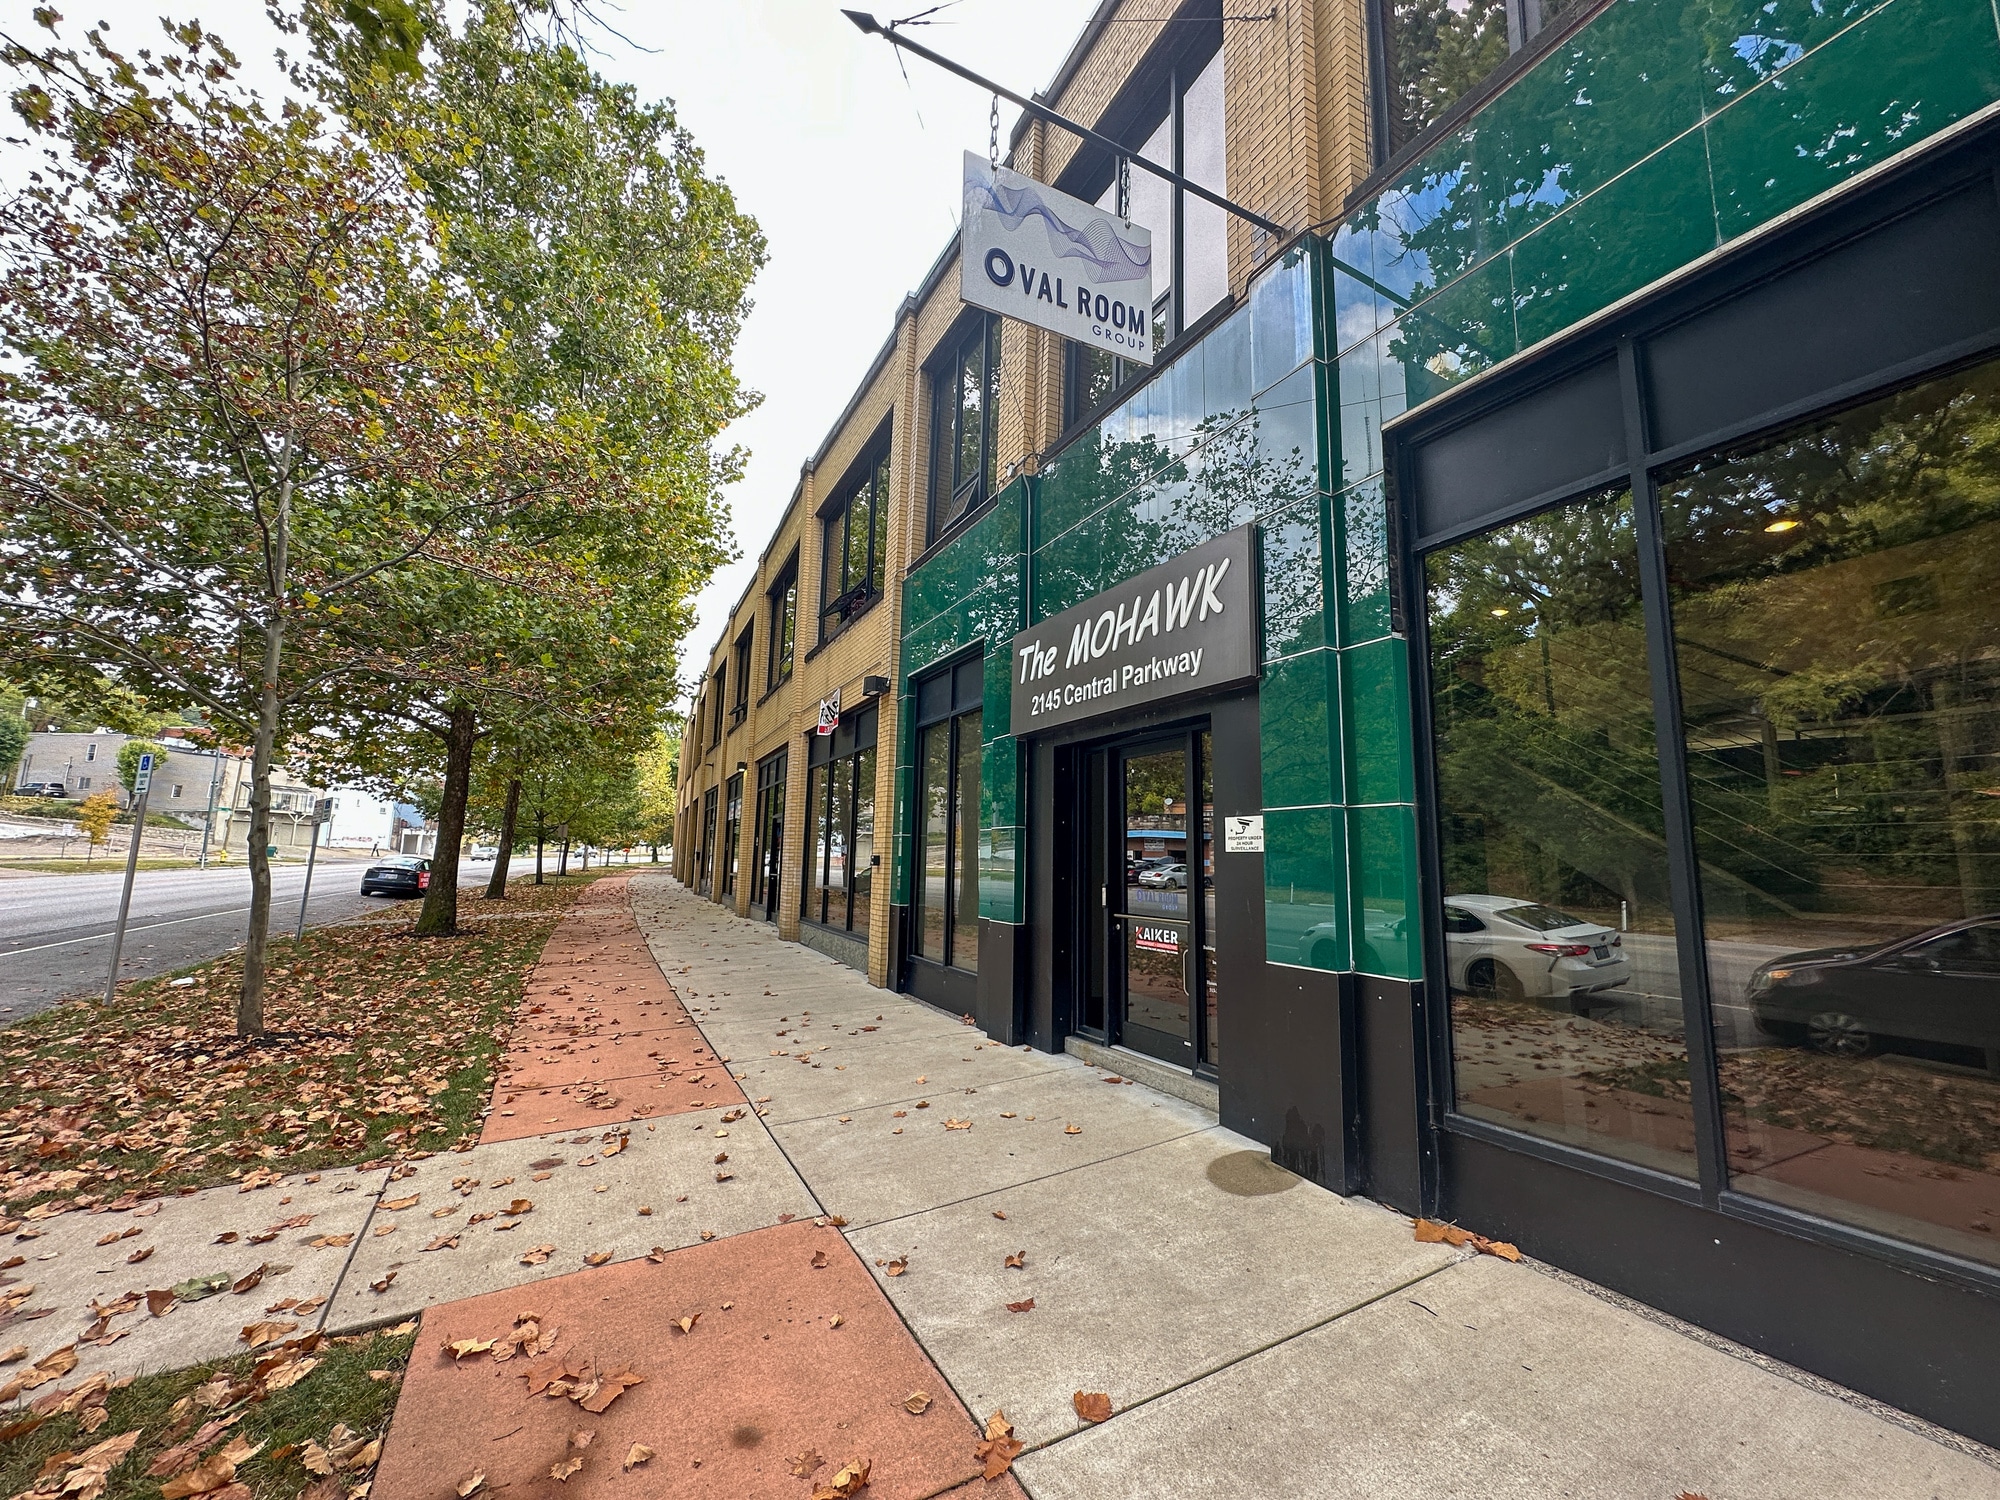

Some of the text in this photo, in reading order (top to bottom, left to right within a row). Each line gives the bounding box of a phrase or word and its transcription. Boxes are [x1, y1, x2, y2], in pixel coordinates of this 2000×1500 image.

[984, 247, 1145, 336] OVAL ROOM
[1092, 325, 1145, 350] GROUP
[1019, 557, 1231, 684] The MOHAWK
[1031, 647, 1203, 716] 2145 Central Parkway
[1136, 888, 1178, 903] OVAL ROOM
[1135, 926, 1178, 944] KAIKER
